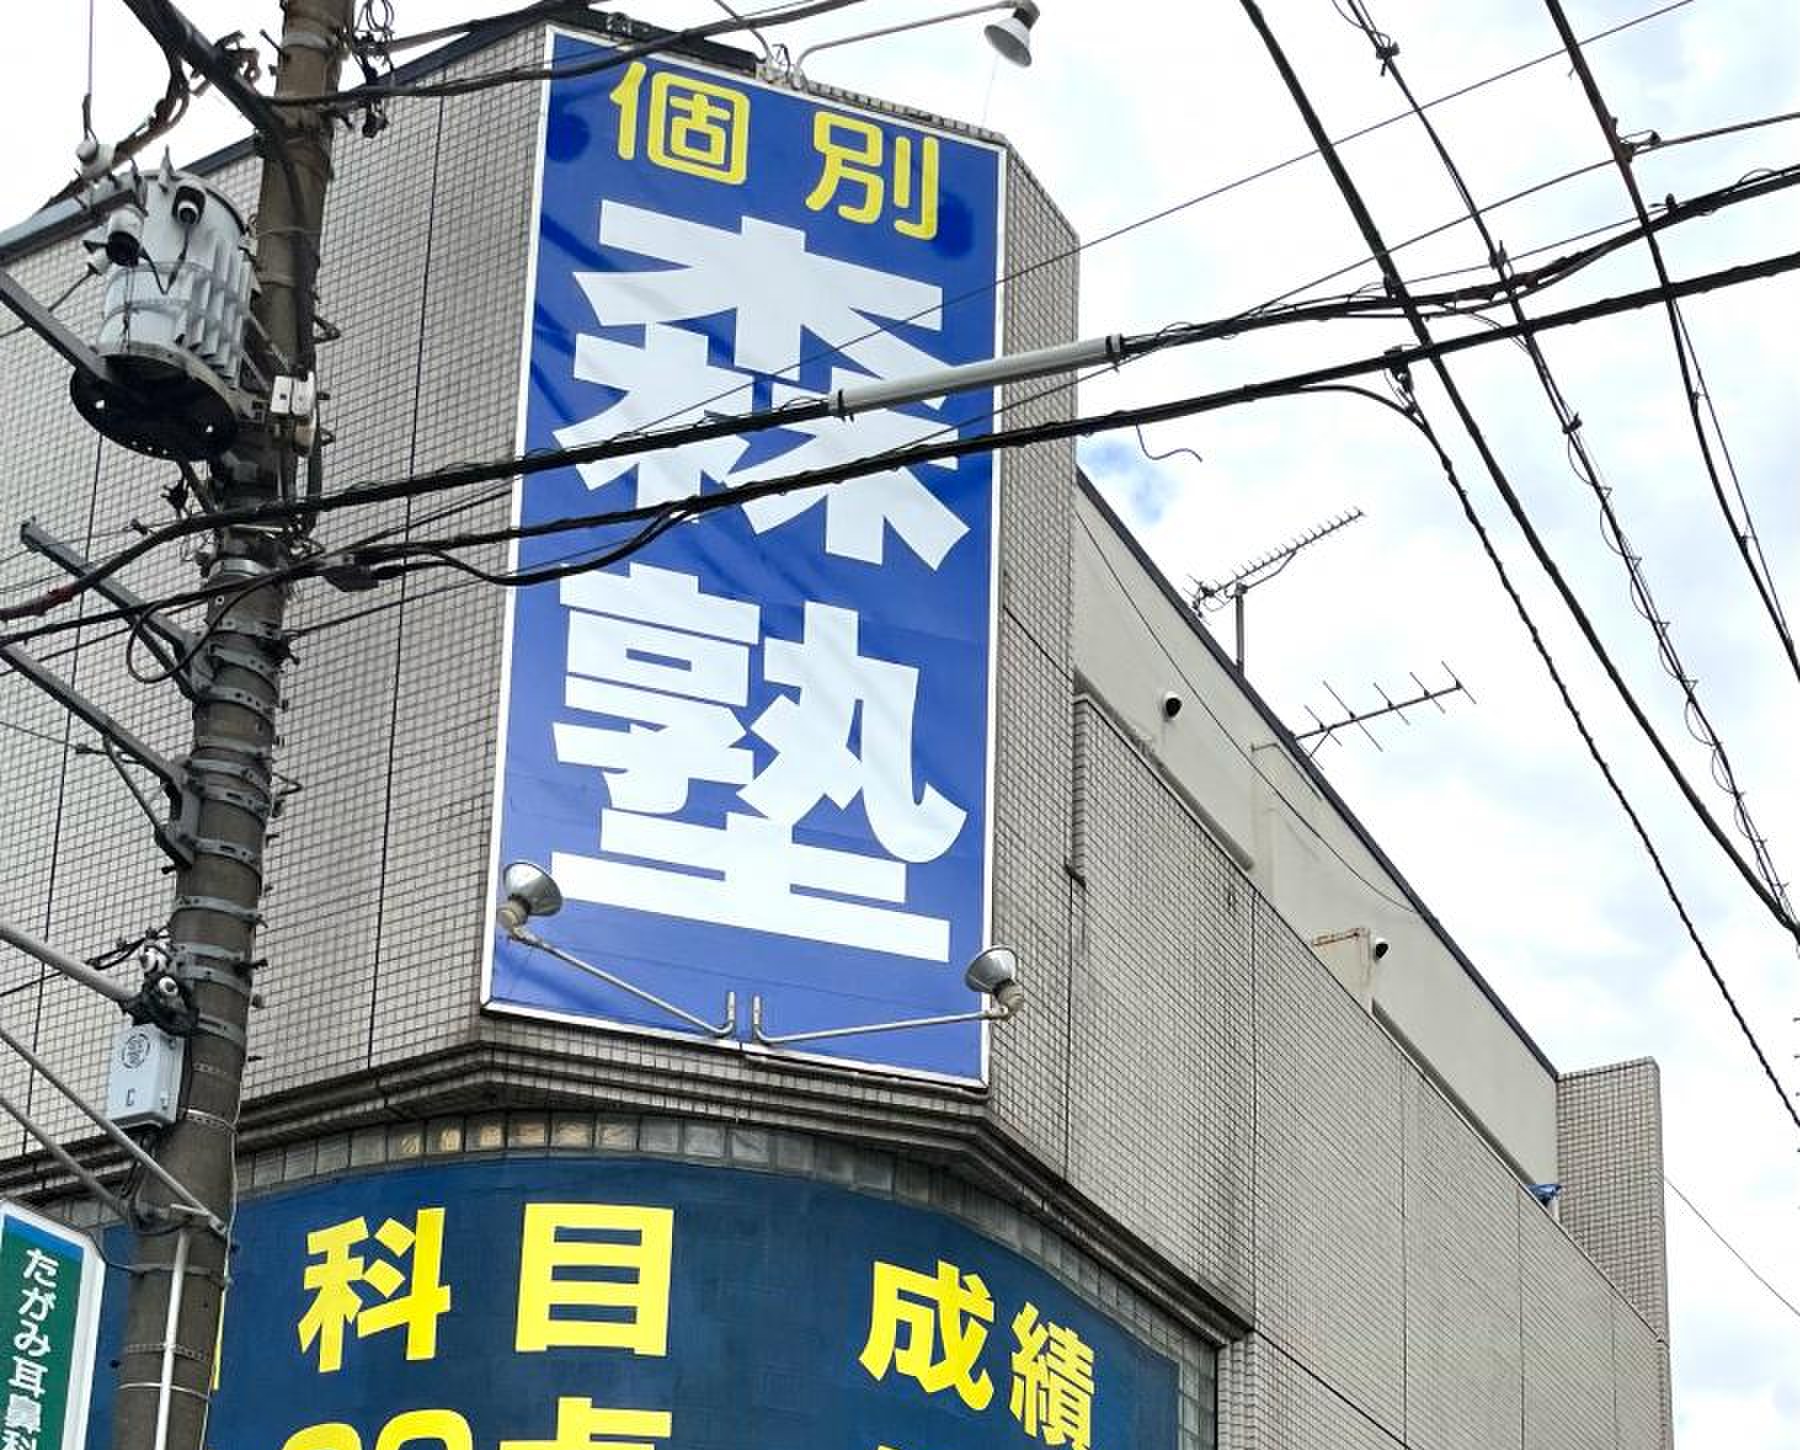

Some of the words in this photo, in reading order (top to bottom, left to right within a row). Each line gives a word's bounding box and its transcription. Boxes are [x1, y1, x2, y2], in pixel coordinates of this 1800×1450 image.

[612, 62, 938, 240] 個別
[552, 199, 971, 962] 森塾
[212, 1204, 673, 1391] 科目
